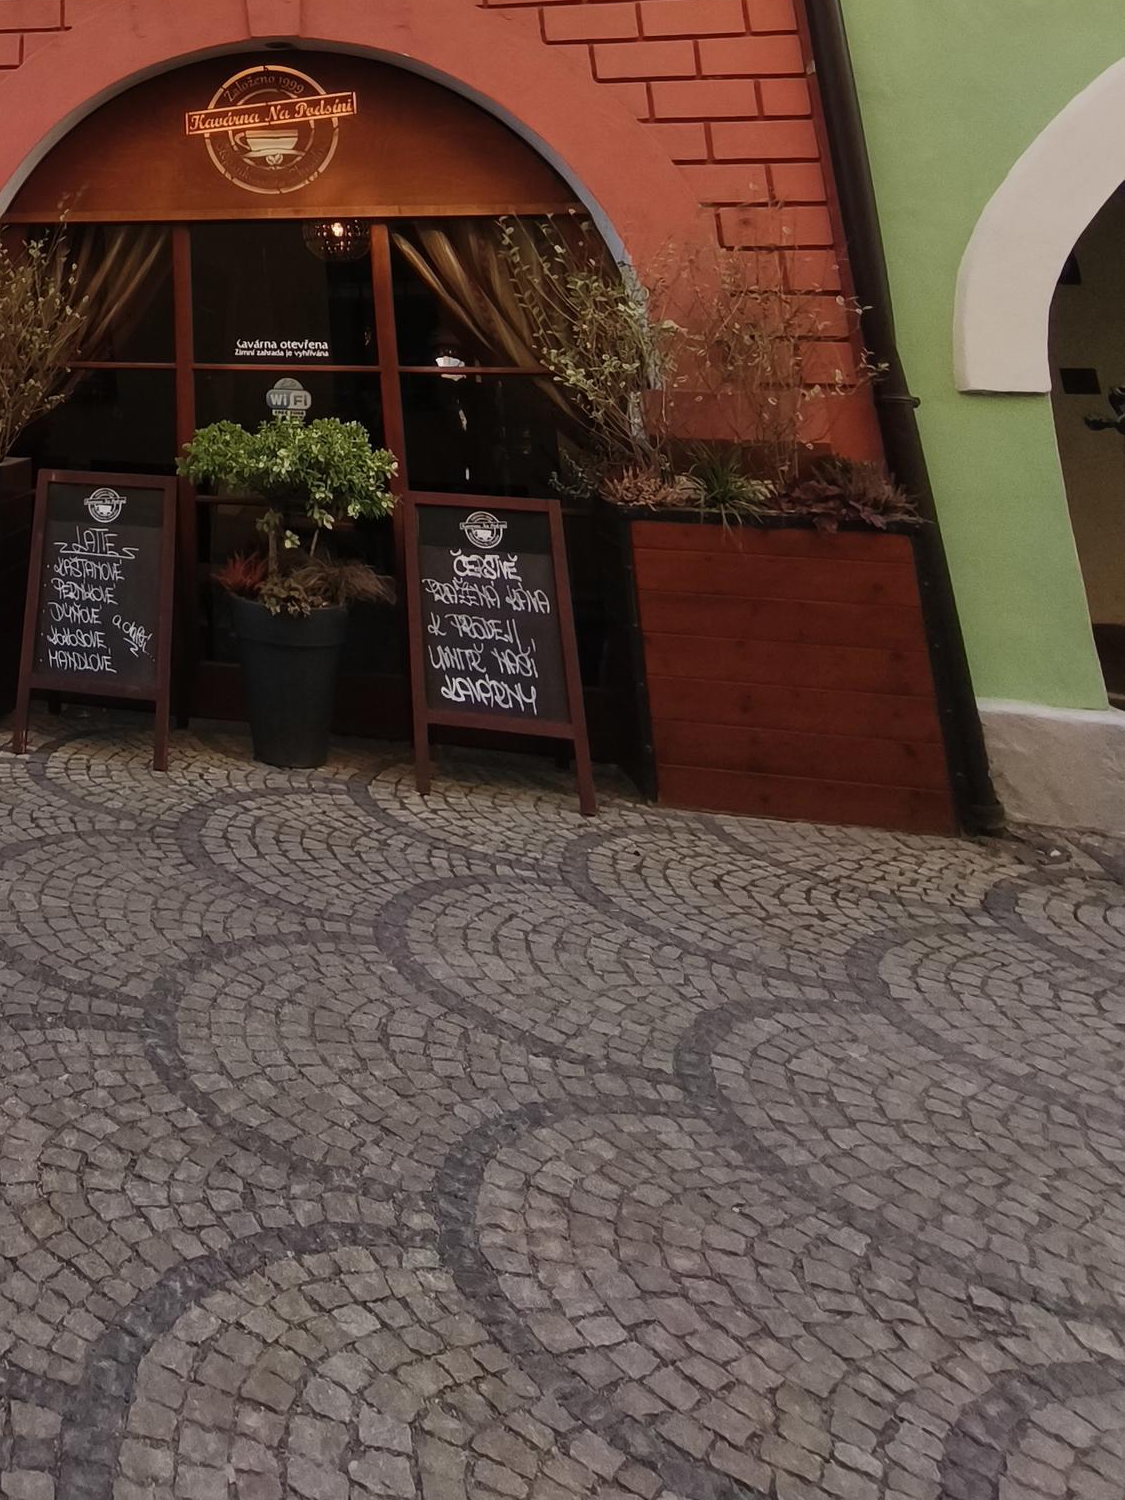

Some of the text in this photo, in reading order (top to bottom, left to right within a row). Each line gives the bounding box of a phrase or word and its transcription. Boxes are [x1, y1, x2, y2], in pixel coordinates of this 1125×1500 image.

[278, 75, 305, 94] 1999
[188, 111, 261, 131] Kavárna
[264, 104, 290, 121] Na
[279, 339, 330, 350] otevřena
[71, 525, 121, 557] LATTE
